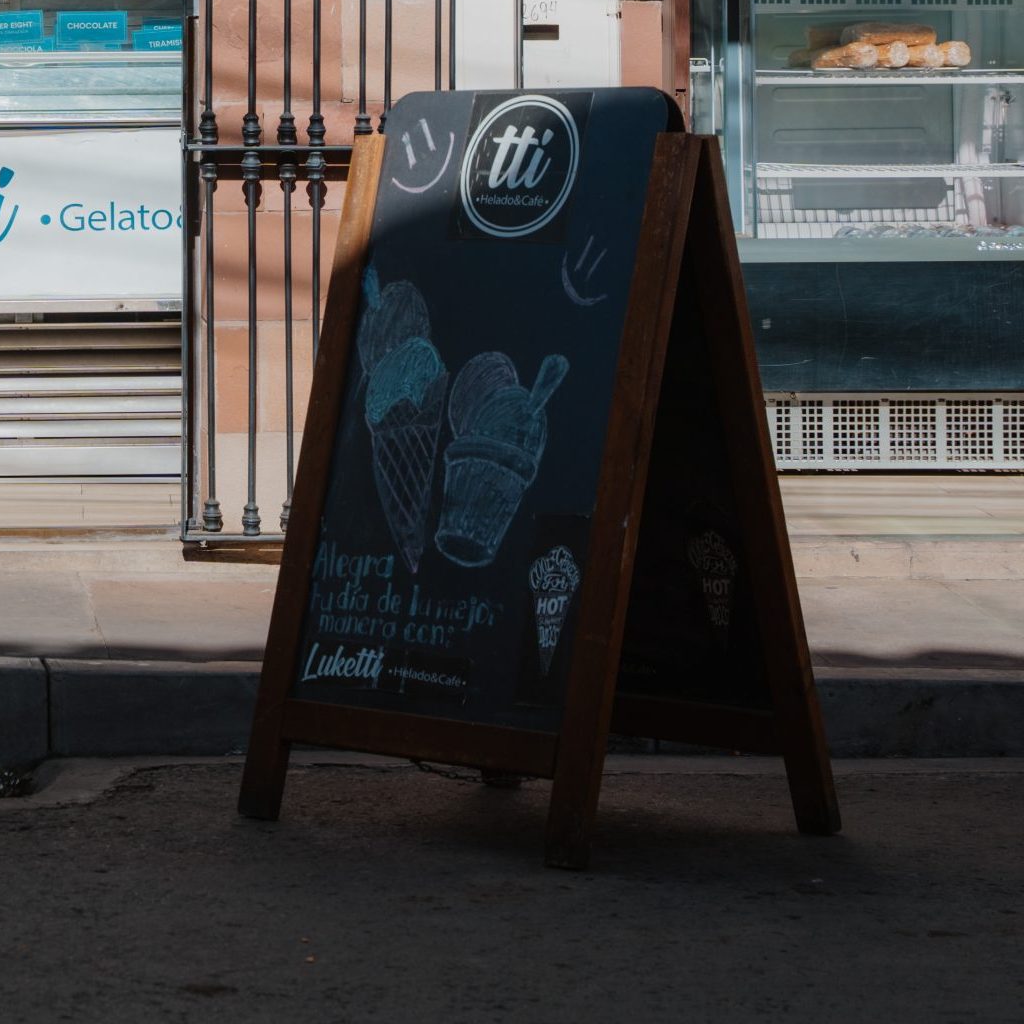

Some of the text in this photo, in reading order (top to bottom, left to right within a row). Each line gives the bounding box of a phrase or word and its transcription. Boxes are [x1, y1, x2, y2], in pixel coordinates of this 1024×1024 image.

[10, 21, 33, 29] EIGHT
[66, 21, 118, 30] CHOCOLATE
[148, 39, 182, 48] TIRAMIS
[488, 124, 555, 190] tti
[312, 540, 394, 588] Alegra
[702, 577, 731, 595] HOT
[377, 582, 401, 614] de
[536, 595, 568, 616] HOT
[301, 641, 385, 683] Luketti
